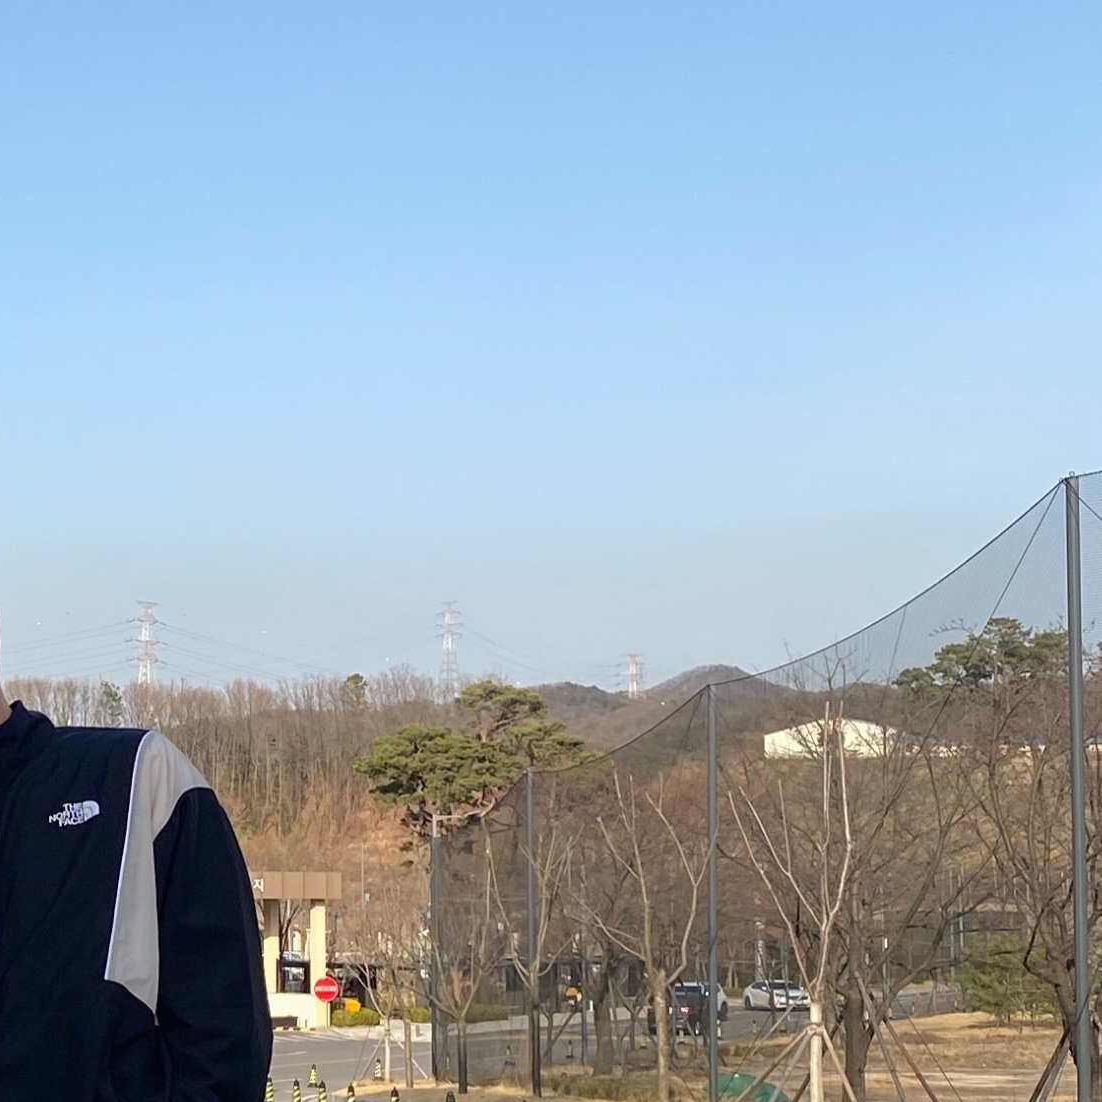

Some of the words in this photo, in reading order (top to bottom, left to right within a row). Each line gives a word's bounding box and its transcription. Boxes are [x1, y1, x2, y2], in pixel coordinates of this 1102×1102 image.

[63, 802, 83, 812] THE
[49, 810, 84, 823] NORTH
[59, 817, 85, 827] FACE
